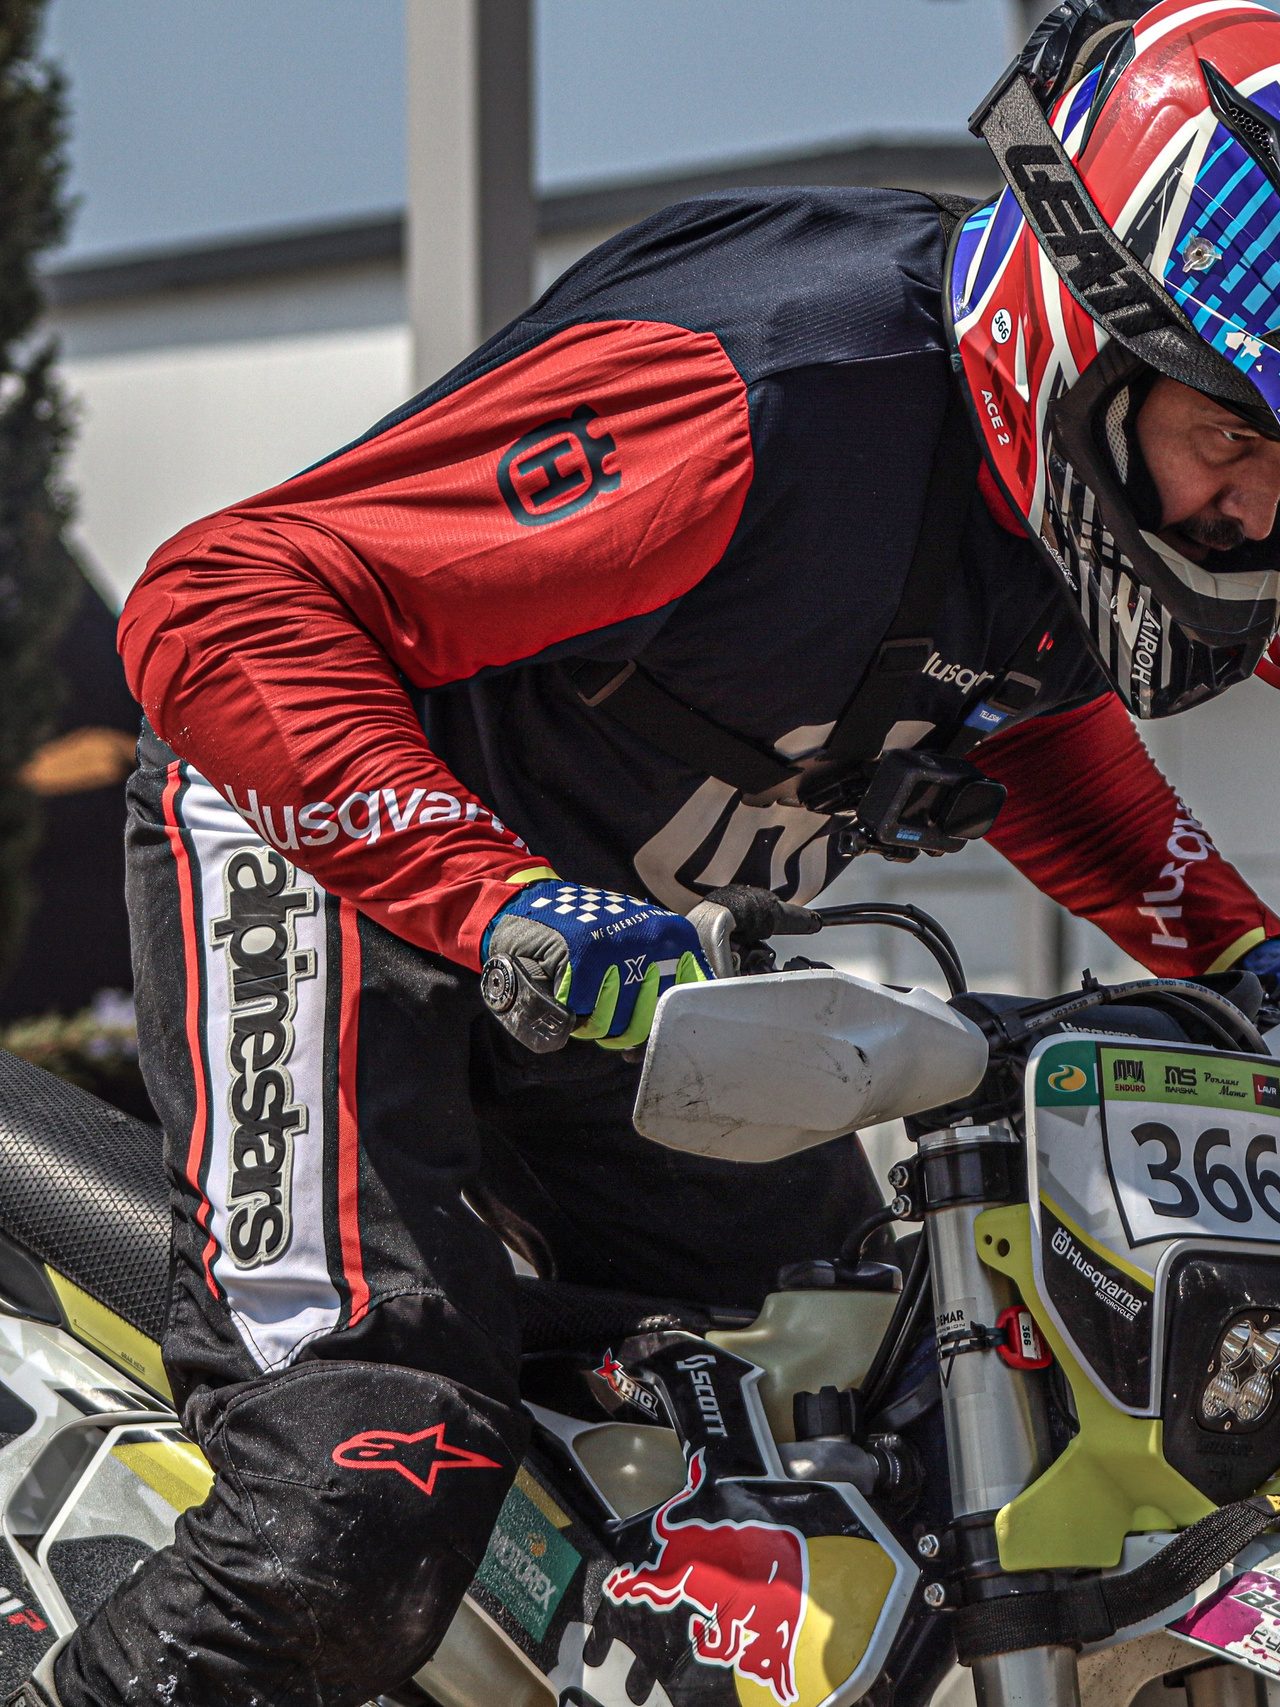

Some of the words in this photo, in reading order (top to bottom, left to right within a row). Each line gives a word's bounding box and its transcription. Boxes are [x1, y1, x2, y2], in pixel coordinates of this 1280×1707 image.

[1005, 144, 1187, 338] LEATT
[994, 312, 1010, 340] 366
[981, 390, 1004, 429] ACE
[997, 432, 1010, 446] 2
[1131, 608, 1161, 686] AIROH
[606, 911, 650, 935] CHERISH
[212, 850, 309, 1263] alpinestars
[1114, 1083, 1146, 1093] ENDURO
[1164, 1086, 1199, 1096] MARSHAL
[1257, 1084, 1277, 1095] LAVR
[1066, 1245, 1143, 1314] Husqvarna
[1095, 1290, 1135, 1321] MOTORCYCLES
[1022, 1324, 1032, 1346] 366
[690, 1370, 729, 1438] SCOTT
